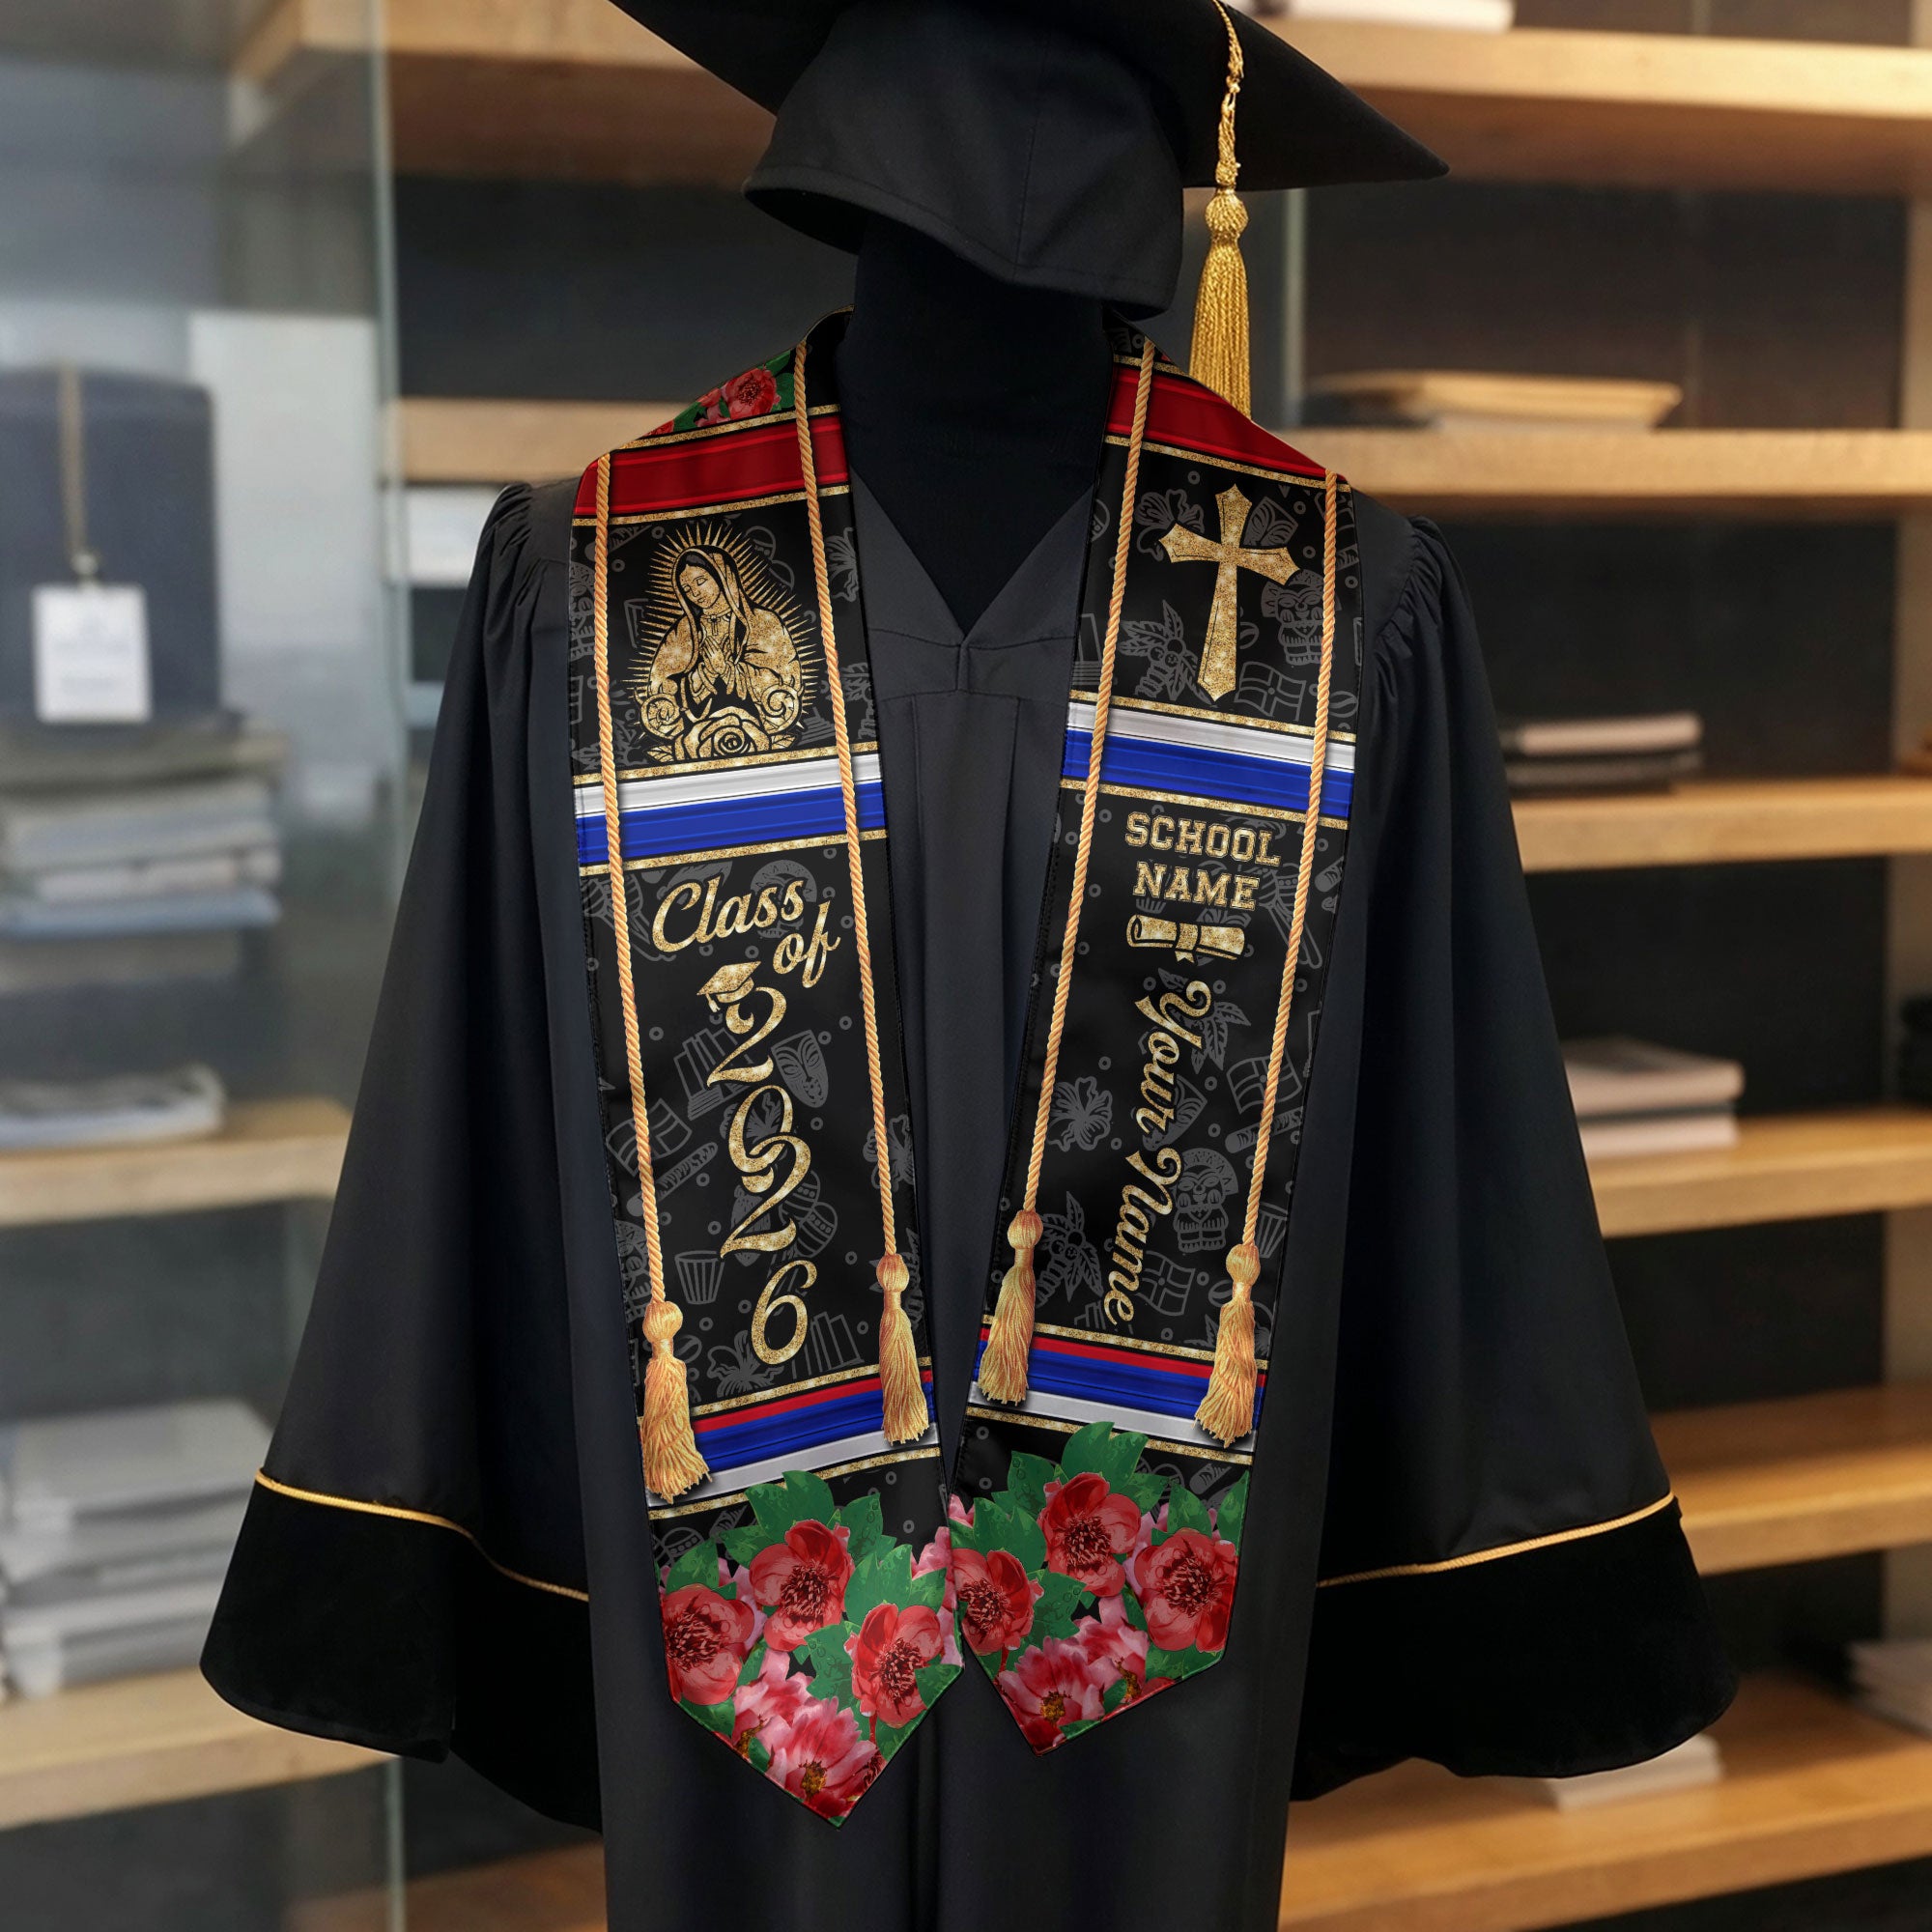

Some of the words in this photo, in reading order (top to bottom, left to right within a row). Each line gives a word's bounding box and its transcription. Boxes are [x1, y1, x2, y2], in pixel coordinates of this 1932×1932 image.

[1124, 811, 1283, 867] SCHOOL
[651, 873, 805, 953] Class
[1132, 861, 1261, 911] NAME
[772, 897, 841, 988] of
[1133, 980, 1211, 1137] Your
[706, 985, 817, 1366] 2026
[1103, 1147, 1181, 1326] Name
